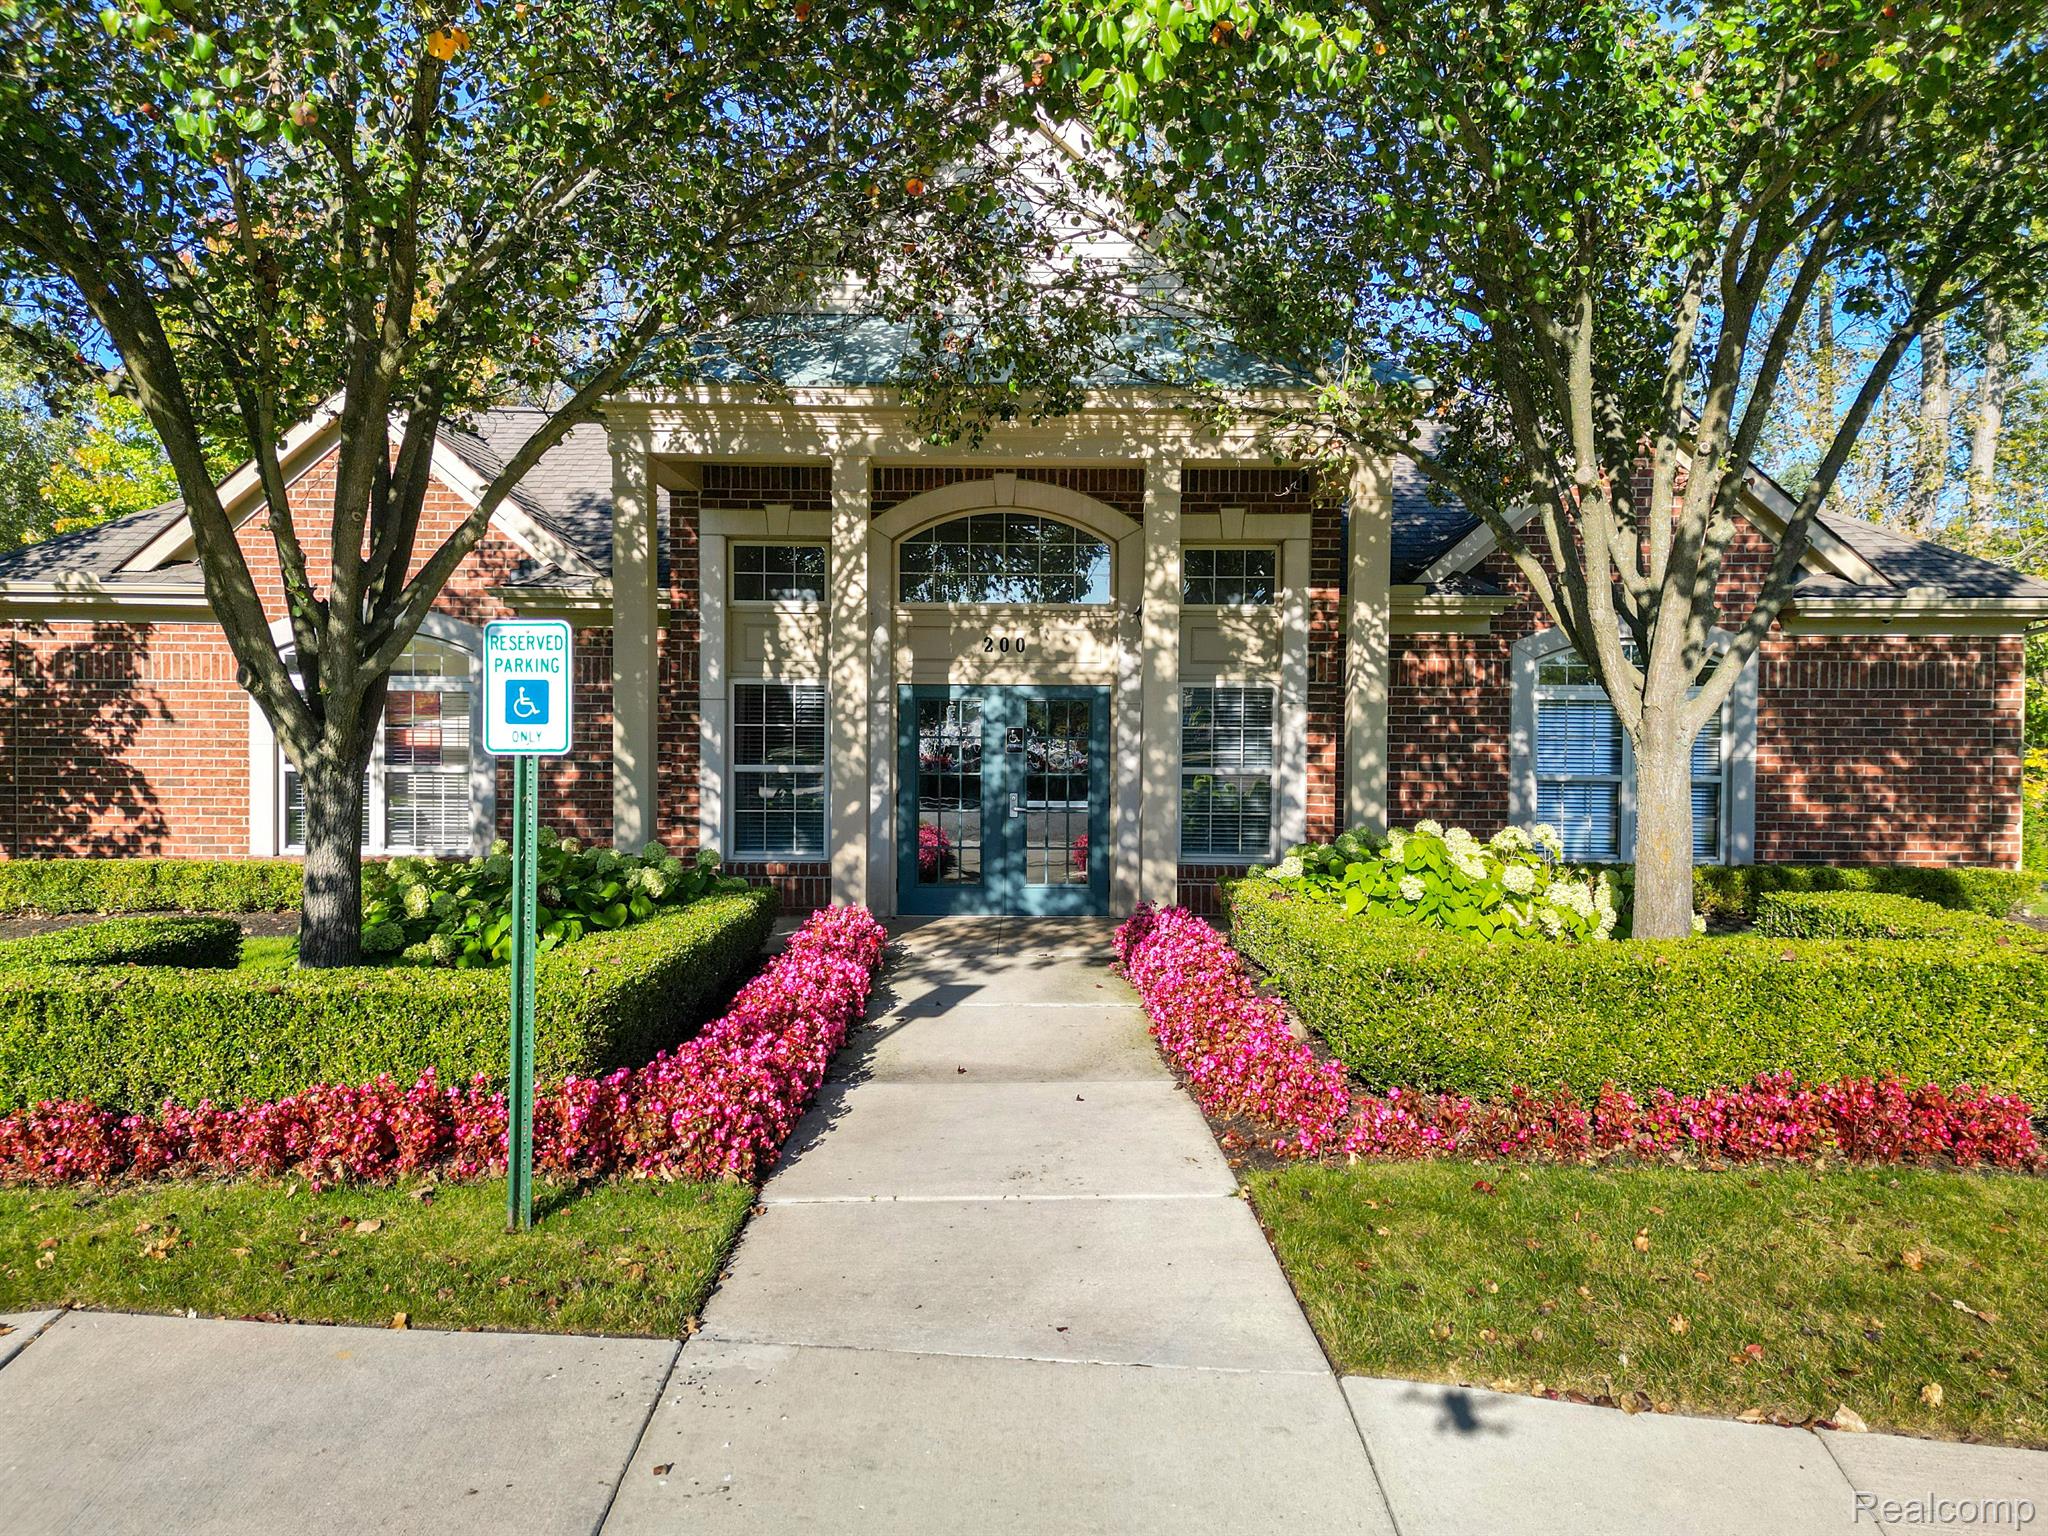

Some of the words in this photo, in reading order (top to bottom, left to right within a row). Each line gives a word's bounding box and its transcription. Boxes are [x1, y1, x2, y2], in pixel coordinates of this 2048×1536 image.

[490, 635, 563, 651] RESERVED
[983, 637, 1026, 653] 200
[494, 657, 560, 673] PARKING
[512, 731, 542, 743] ONLY
